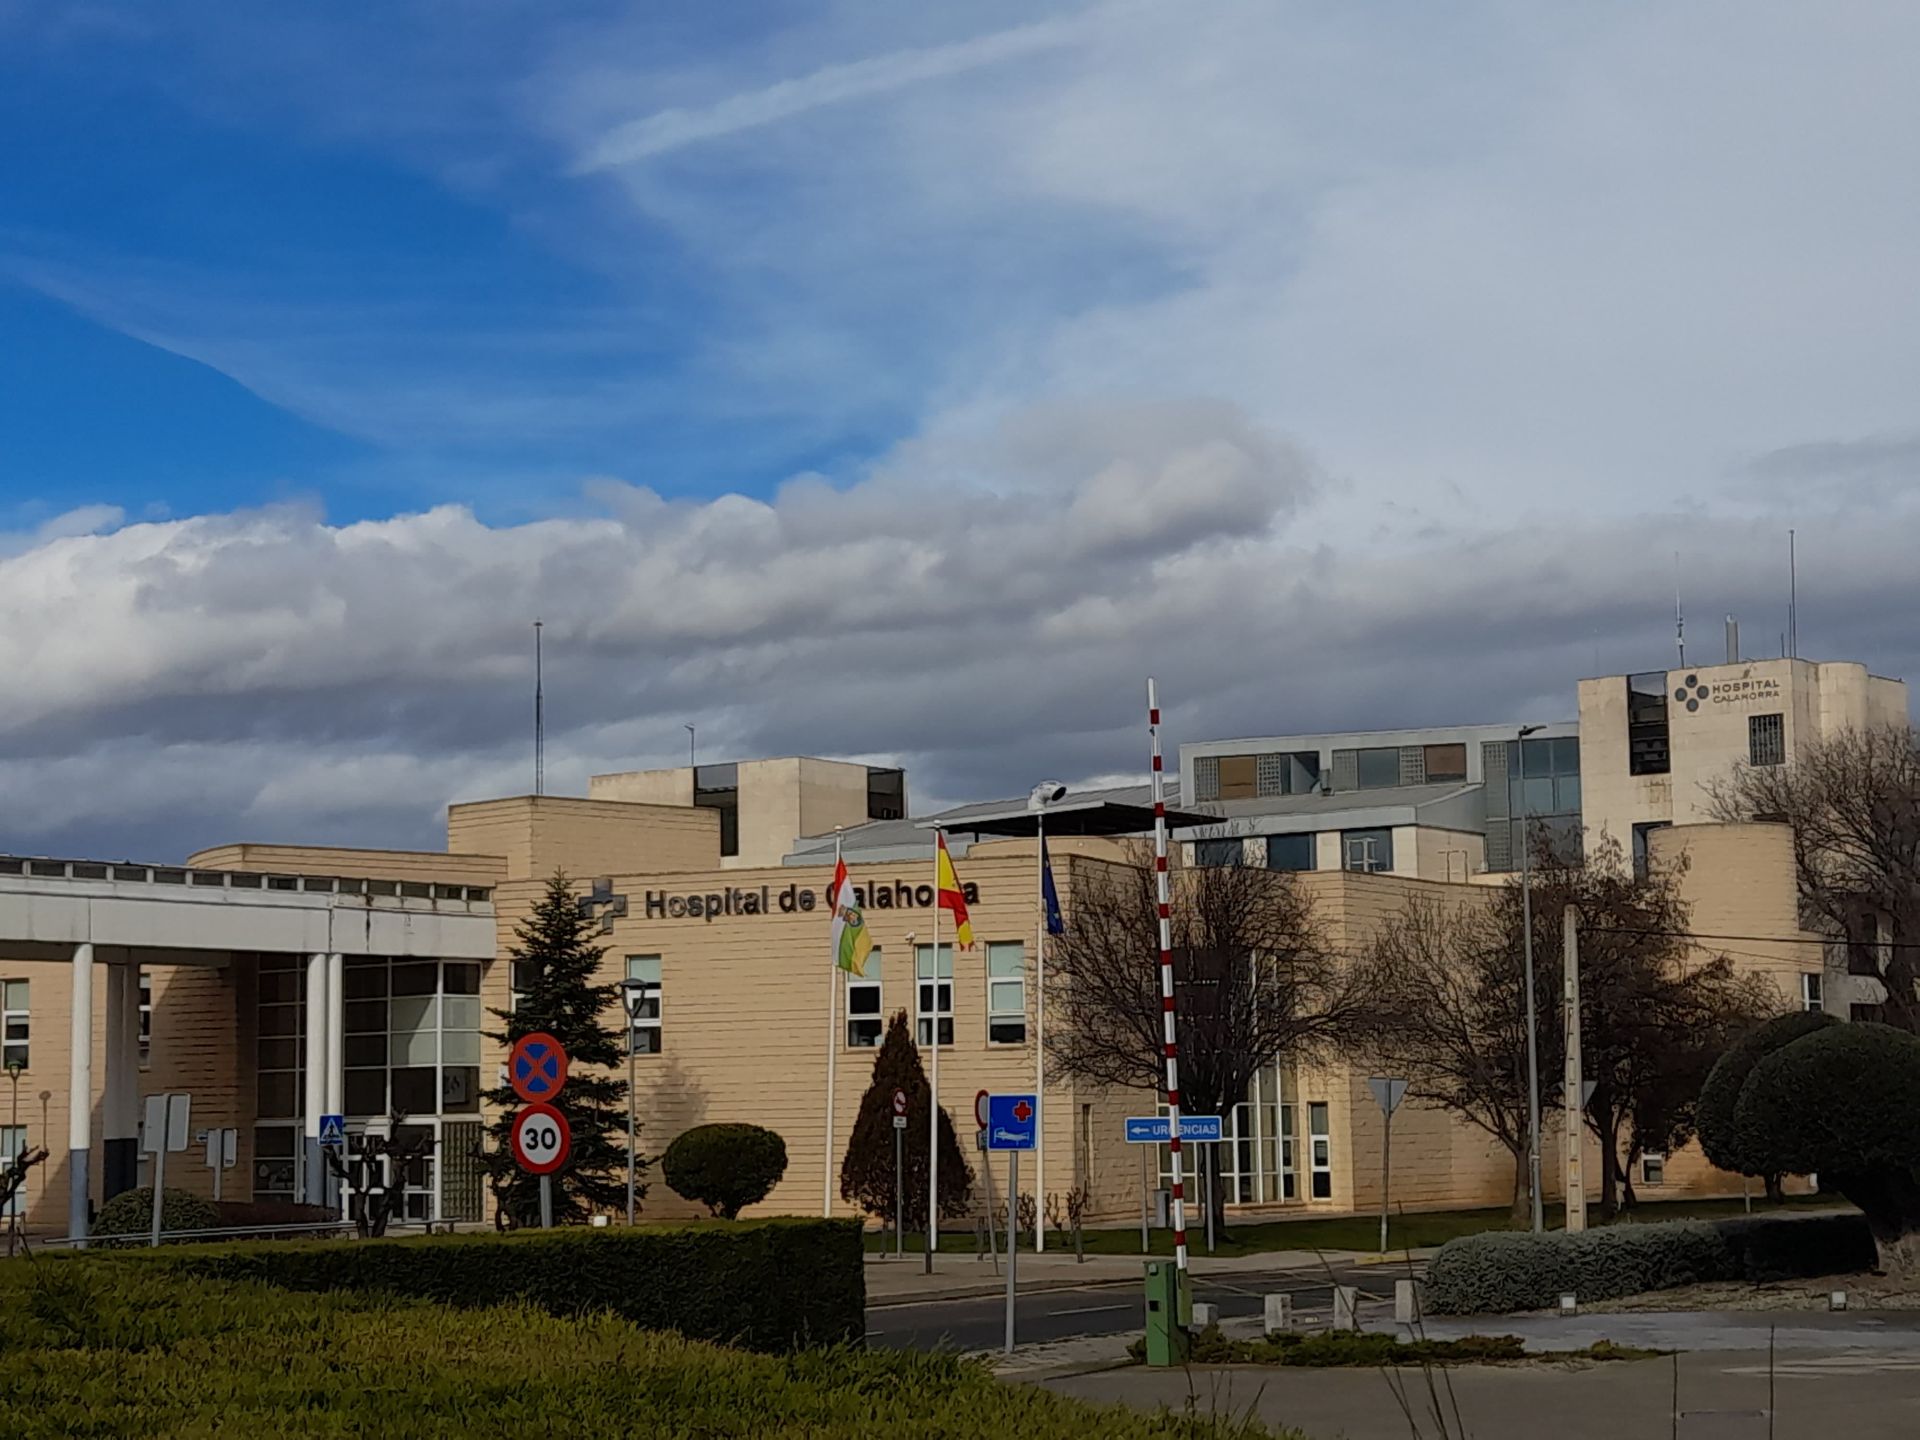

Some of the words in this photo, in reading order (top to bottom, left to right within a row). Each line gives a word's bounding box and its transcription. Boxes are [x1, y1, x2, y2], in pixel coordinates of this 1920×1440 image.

[1712, 679, 1780, 694] HOSPITAL
[1713, 690, 1780, 704] CALAHORRA
[645, 884, 770, 922] Hospital
[778, 883, 817, 911] de
[826, 880, 980, 910] alahoa
[1152, 1124, 1217, 1135] URENCIAS
[525, 1127, 556, 1150] 30
